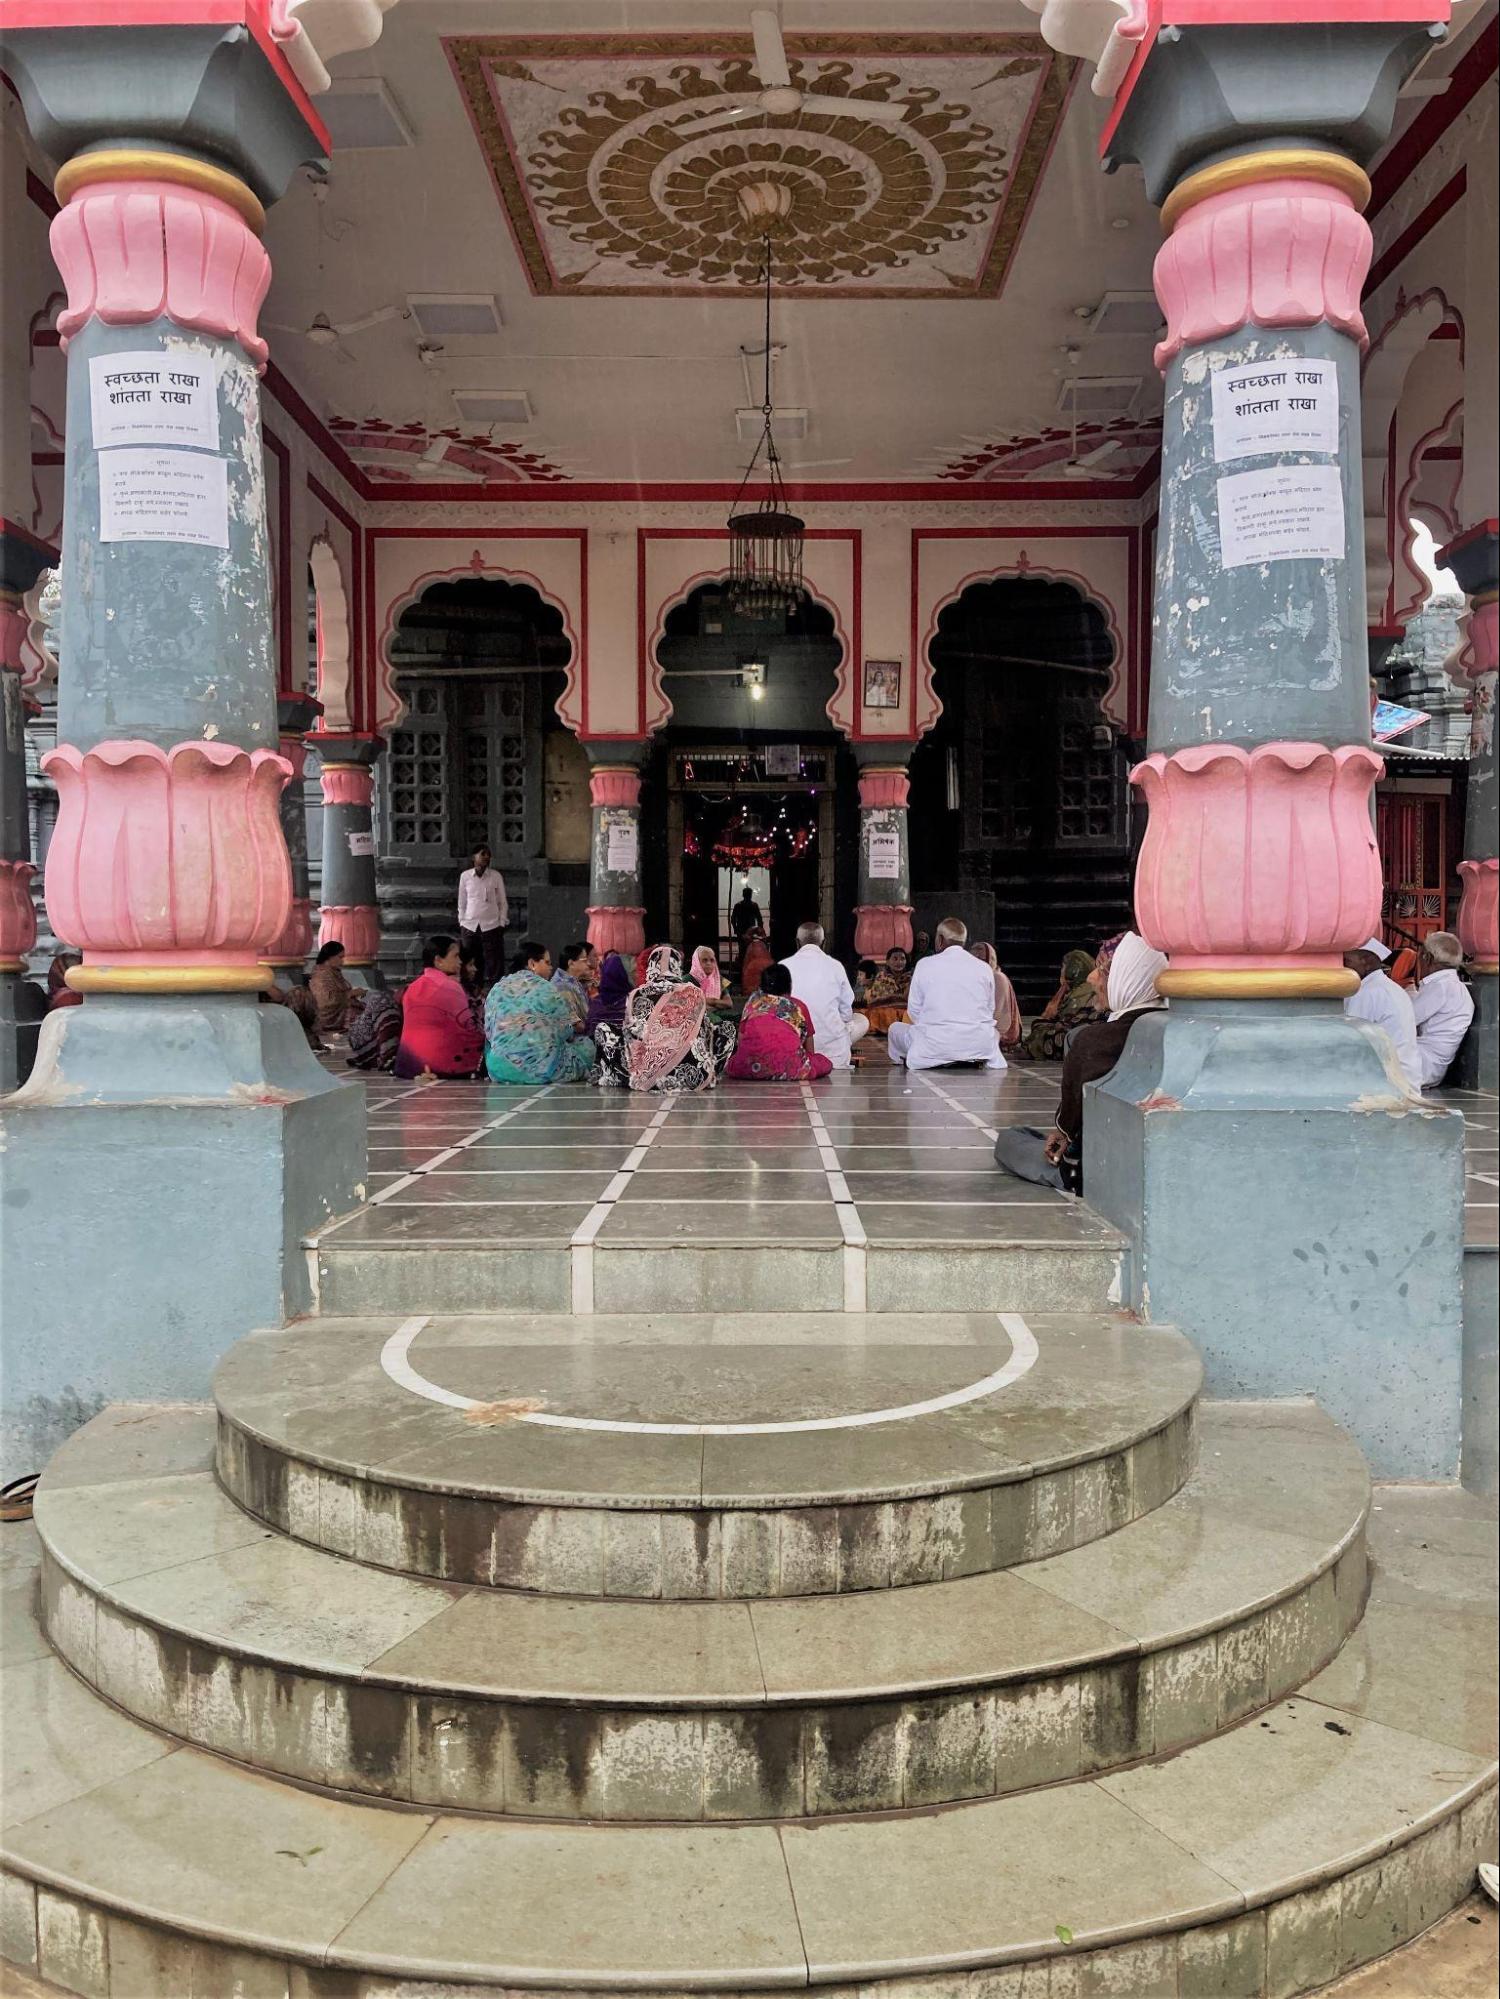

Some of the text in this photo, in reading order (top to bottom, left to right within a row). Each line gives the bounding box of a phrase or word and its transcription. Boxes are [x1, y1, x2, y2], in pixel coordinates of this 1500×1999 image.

[104, 372, 200, 388] स्वच्छता राखा
[1227, 372, 1323, 392] स्वच्छता राखा
[109, 387, 192, 405] शांतता राखा
[1235, 398, 1317, 416] शांतता राखा
